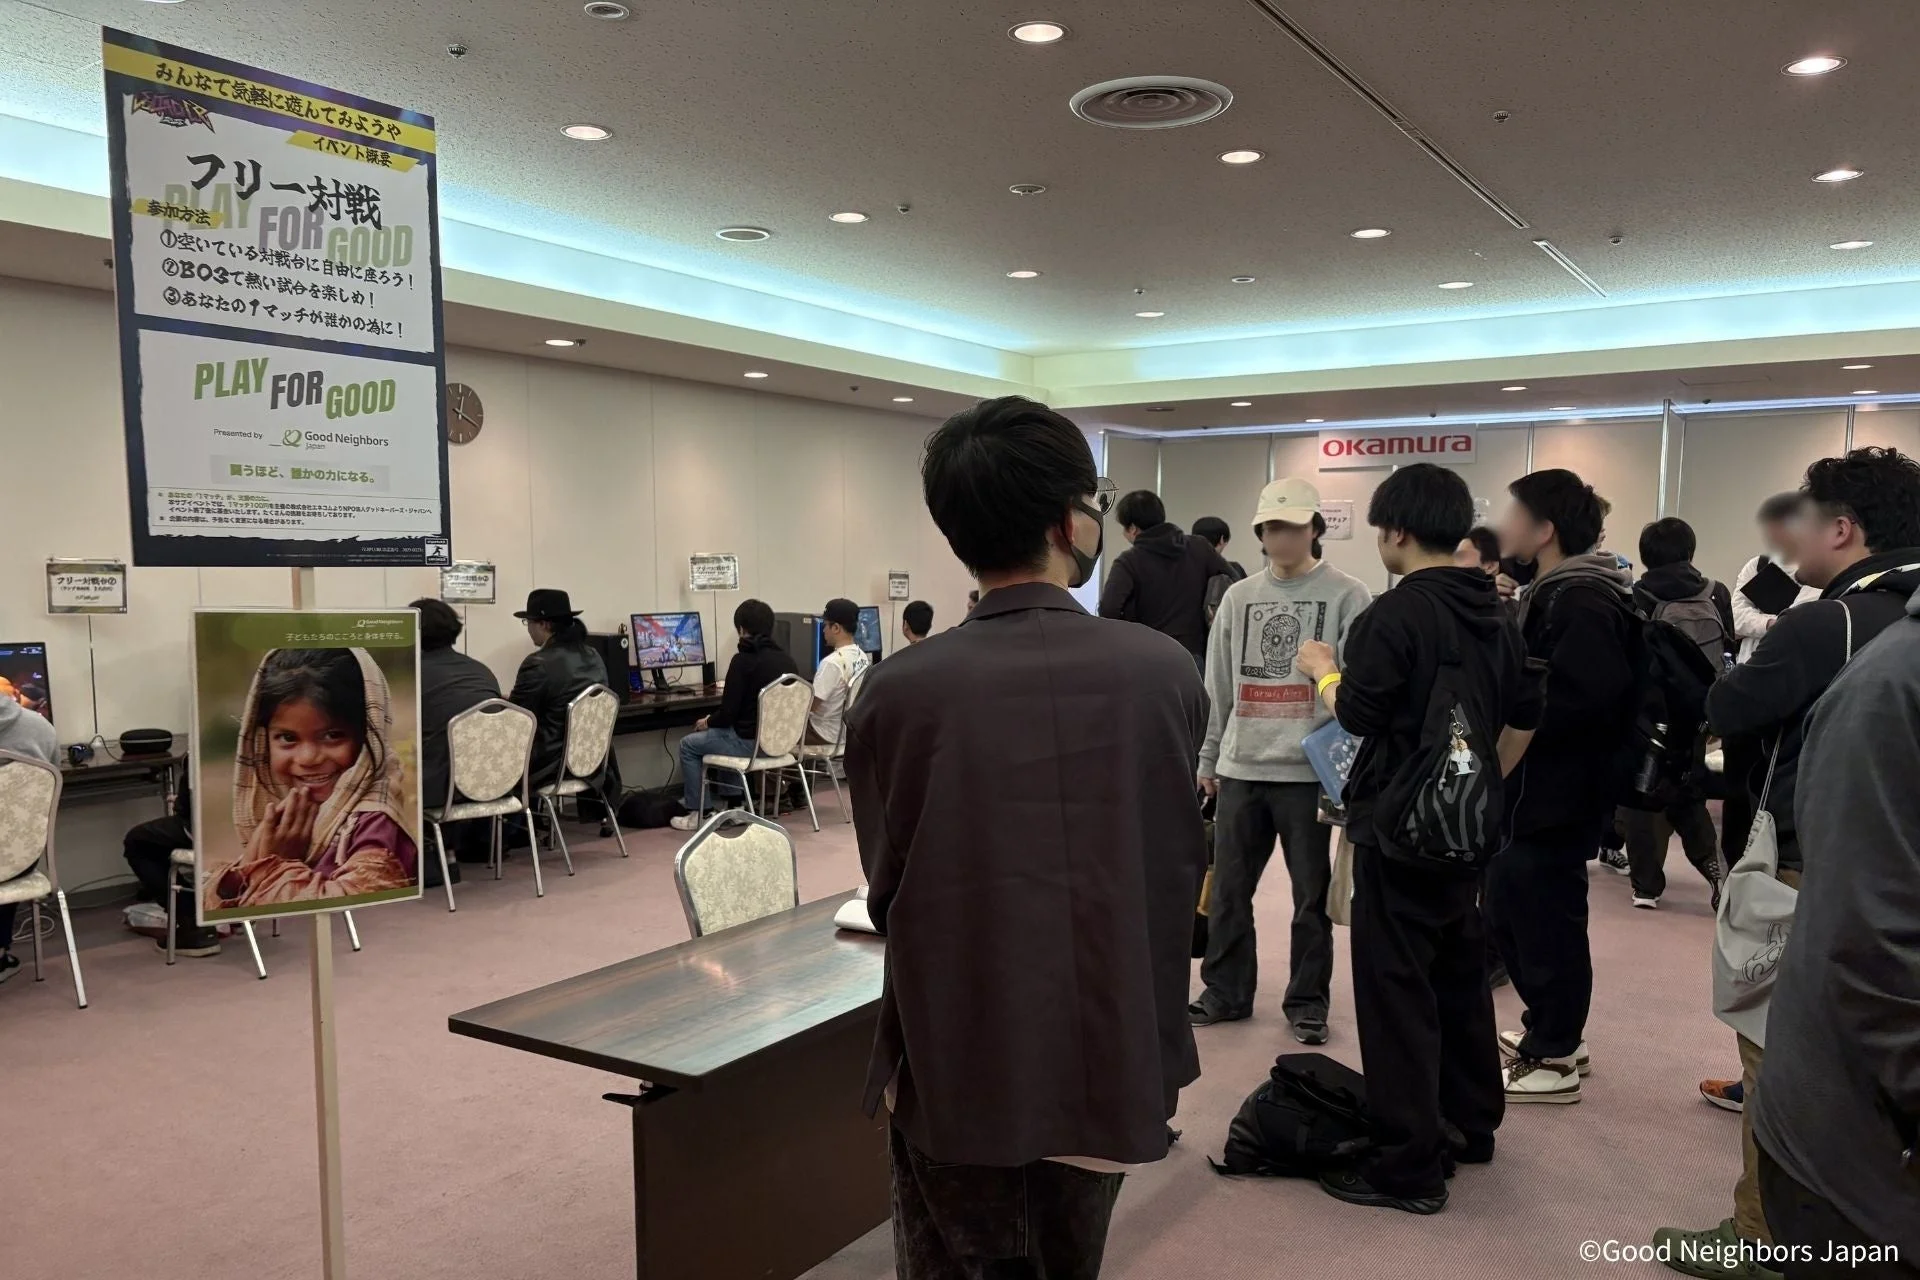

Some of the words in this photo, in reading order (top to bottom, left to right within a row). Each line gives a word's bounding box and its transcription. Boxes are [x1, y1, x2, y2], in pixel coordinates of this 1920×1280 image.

[156, 62, 402, 140] みんなで気軽に遊んでみようや
[313, 136, 393, 168] イベント概要
[146, 199, 212, 227] 参加方法
[186, 153, 383, 230] フリー対戦
[259, 205, 325, 250] FOR
[327, 225, 413, 268] GOOD
[194, 357, 269, 400] PLAY
[270, 370, 324, 410] FOR
[325, 379, 396, 419] GOOD
[213, 428, 252, 438] Presented
[253, 431, 263, 440] by
[304, 431, 333, 443] Good
[335, 433, 389, 447] Neighbors
